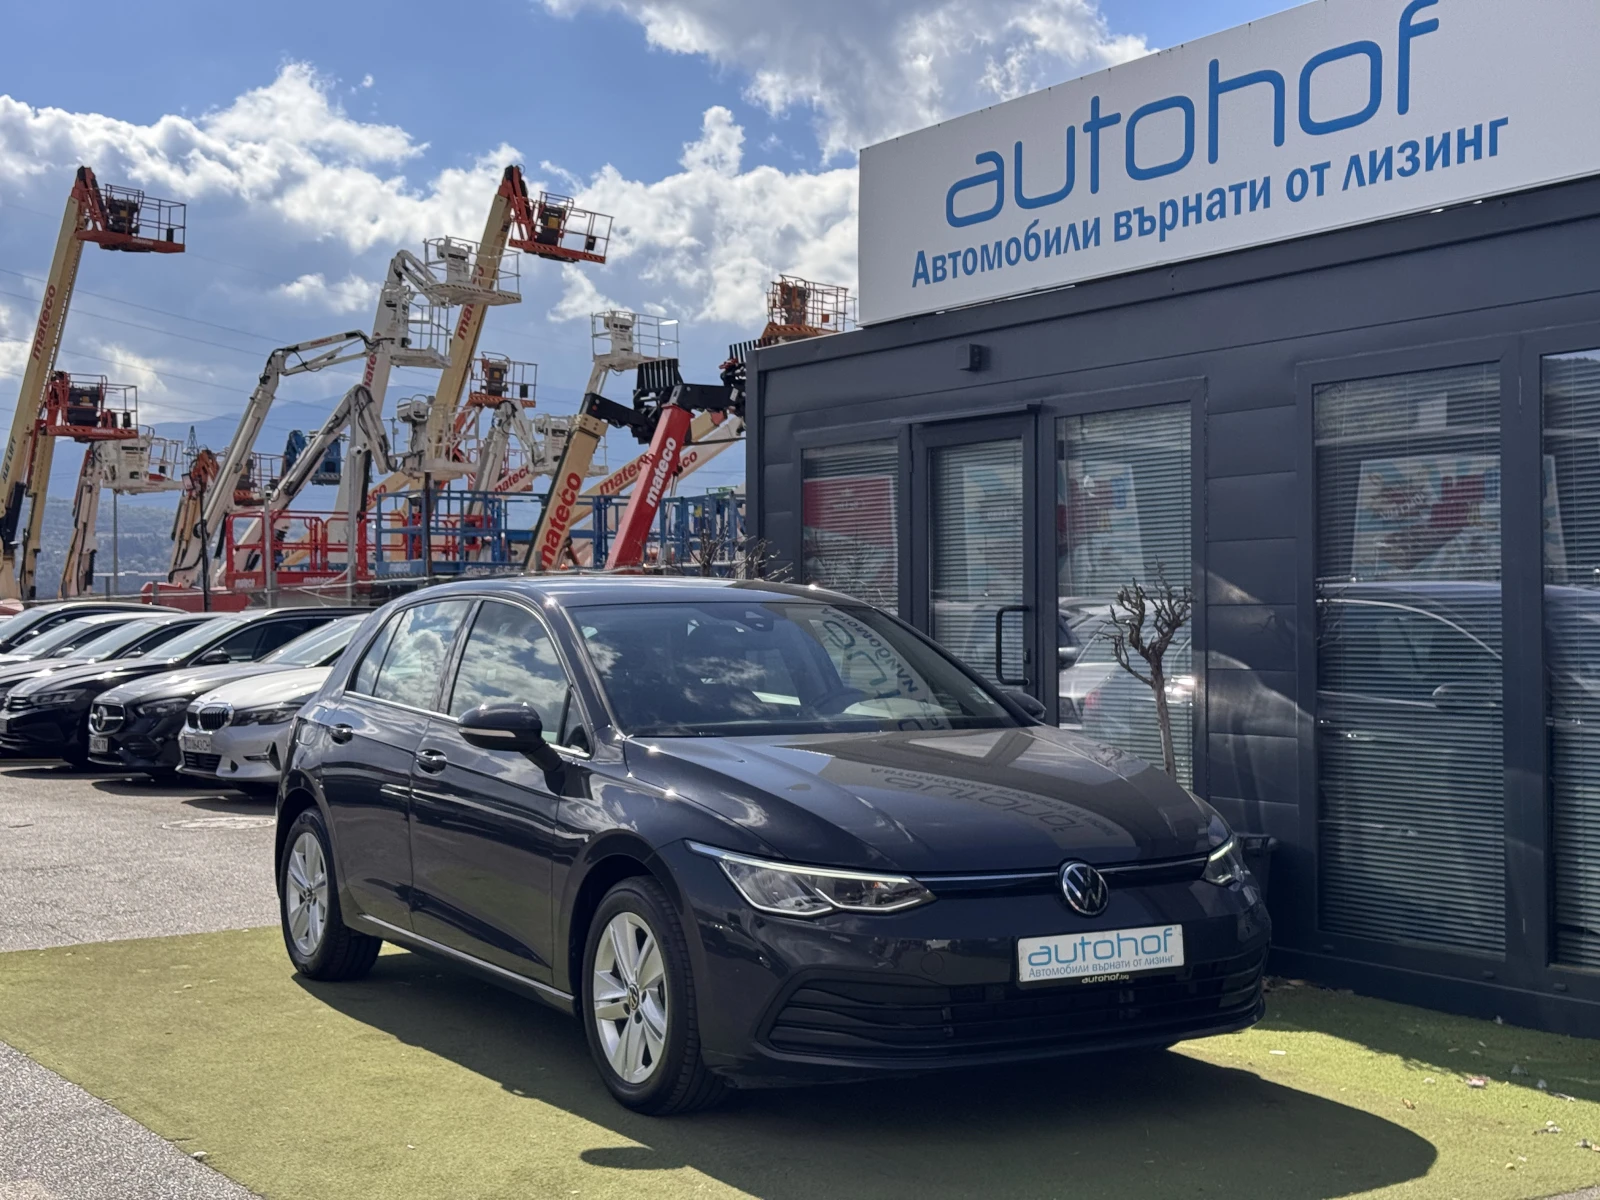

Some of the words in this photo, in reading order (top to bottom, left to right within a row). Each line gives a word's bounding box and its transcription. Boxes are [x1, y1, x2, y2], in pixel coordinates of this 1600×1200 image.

[945, 0, 1440, 229] autohof
[912, 216, 1101, 286] Автомобили
[1113, 175, 1272, 243] върнати
[1284, 160, 1332, 203] от
[1342, 116, 1509, 191] лизинг
[33, 285, 55, 360] mateco
[646, 437, 676, 507] mateco
[541, 472, 581, 570] mateco
[1027, 927, 1173, 967] autohof
[1028, 961, 1089, 978] Автомобили
[1092, 959, 1131, 974] върнати
[1133, 958, 1143, 968] от
[1144, 954, 1175, 966] лизинг
[1082, 973, 1130, 984] autohof.bg
